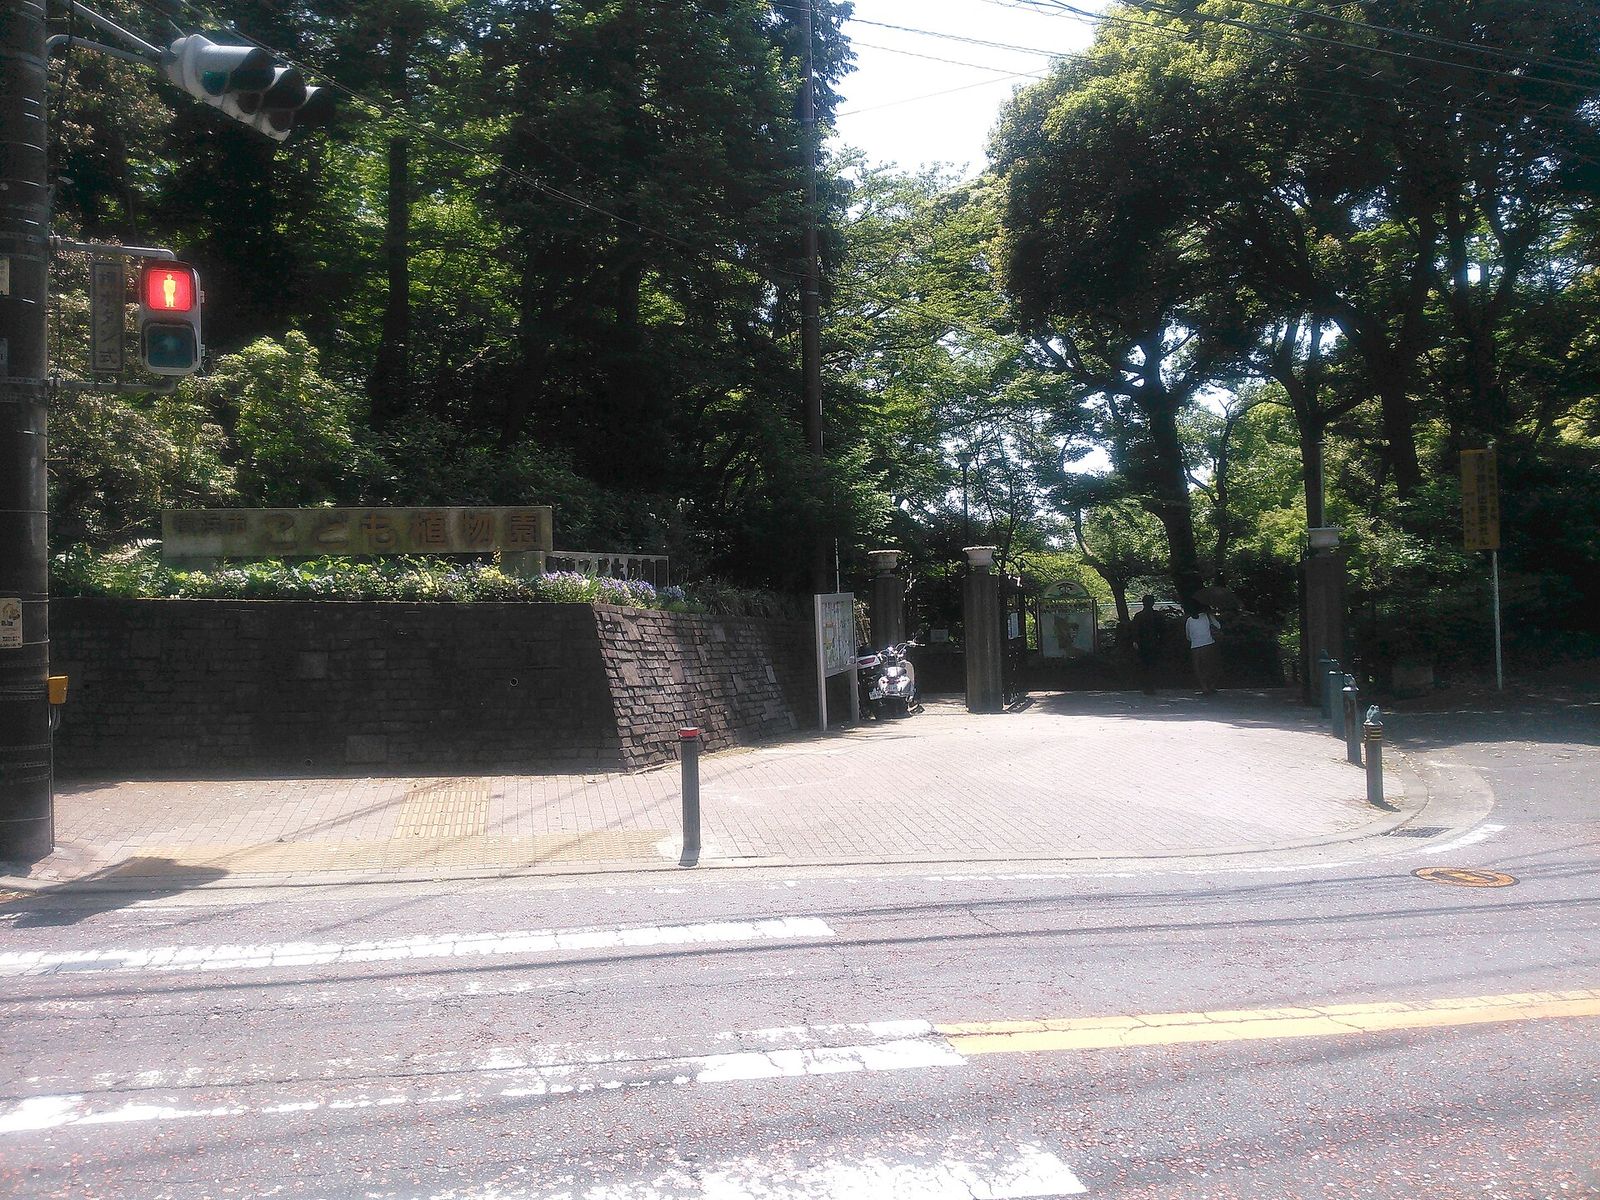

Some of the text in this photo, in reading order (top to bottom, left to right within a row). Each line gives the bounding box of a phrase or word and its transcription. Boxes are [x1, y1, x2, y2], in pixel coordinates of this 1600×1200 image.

[263, 510, 540, 550] こども植物園
